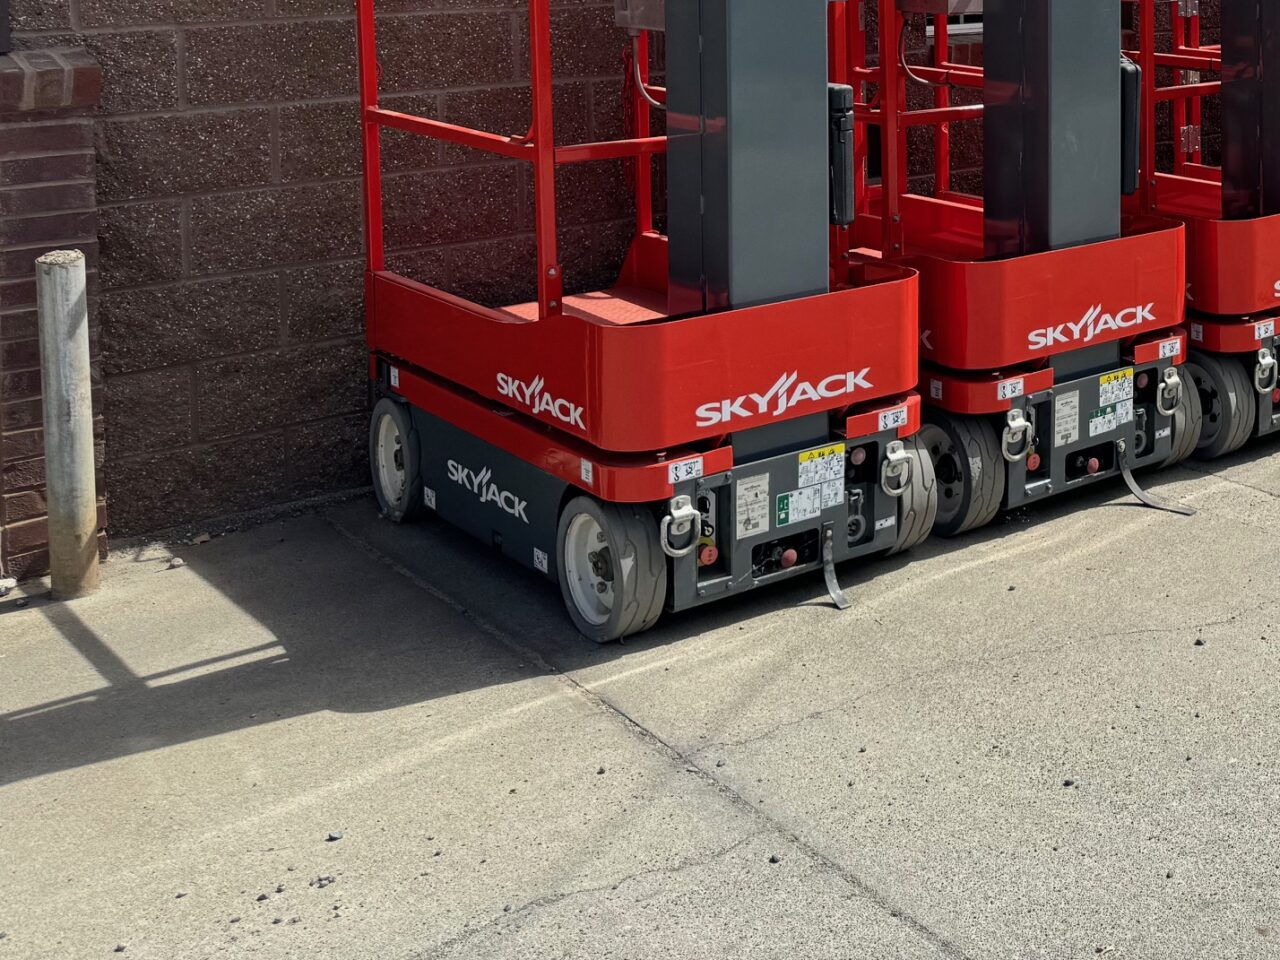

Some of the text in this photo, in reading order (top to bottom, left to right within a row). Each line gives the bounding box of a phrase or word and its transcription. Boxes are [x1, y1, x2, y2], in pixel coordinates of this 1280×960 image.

[1027, 302, 1157, 351] SKYJACK
[496, 372, 588, 431] SKYJACK
[695, 366, 874, 428] SKYJACK
[446, 458, 530, 524] SKYJACK
